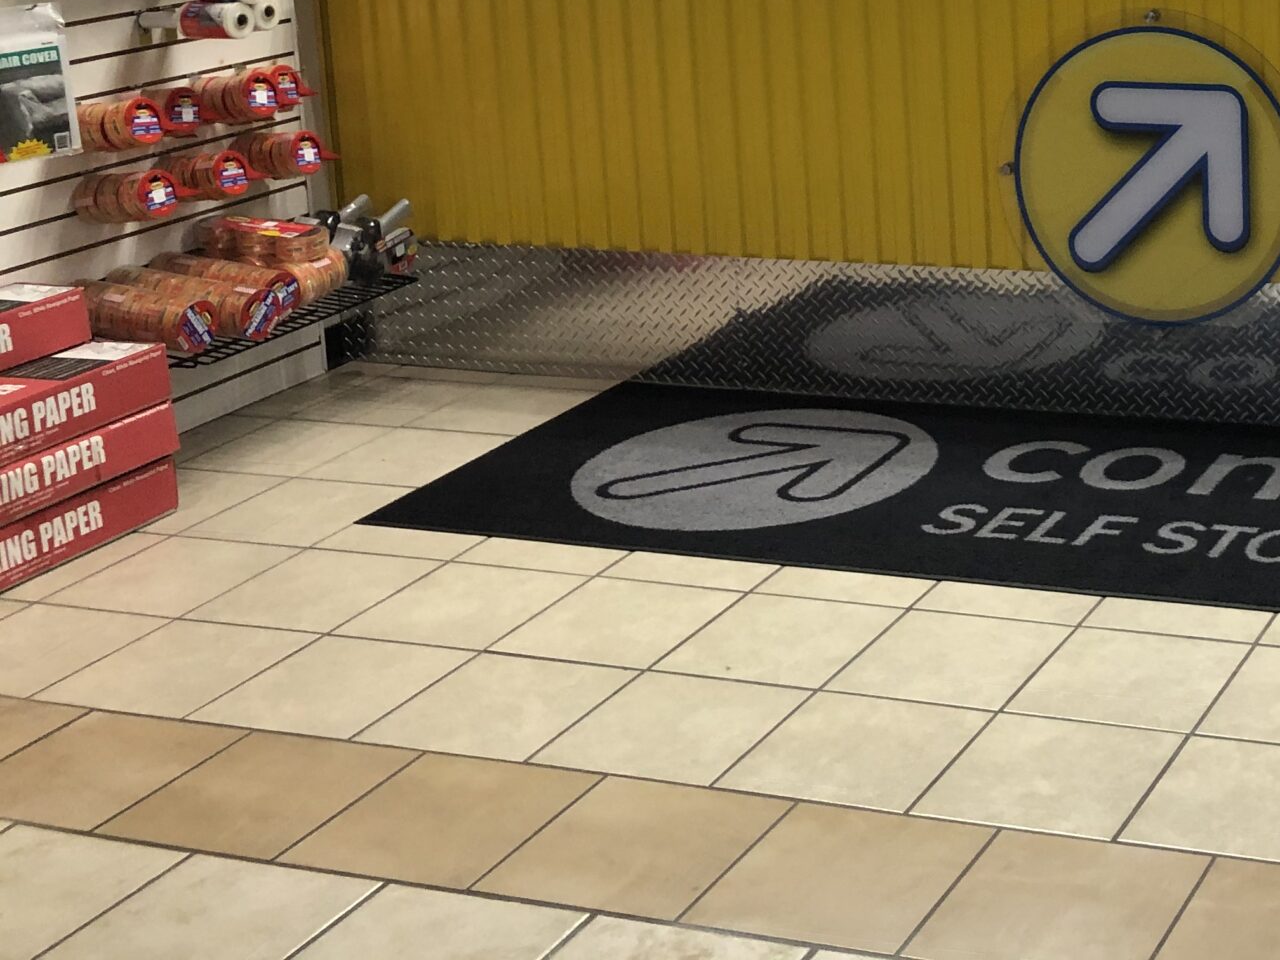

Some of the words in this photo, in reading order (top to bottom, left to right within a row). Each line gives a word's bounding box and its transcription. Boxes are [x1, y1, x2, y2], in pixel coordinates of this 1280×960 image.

[22, 49, 58, 66] COVER
[0, 407, 30, 447] NG
[32, 382, 97, 433] PAPER
[0, 462, 39, 506] ING
[41, 435, 107, 487] PAPER
[0, 529, 37, 573] ING
[39, 500, 104, 553] PAPER
[921, 503, 1139, 547] SELF
